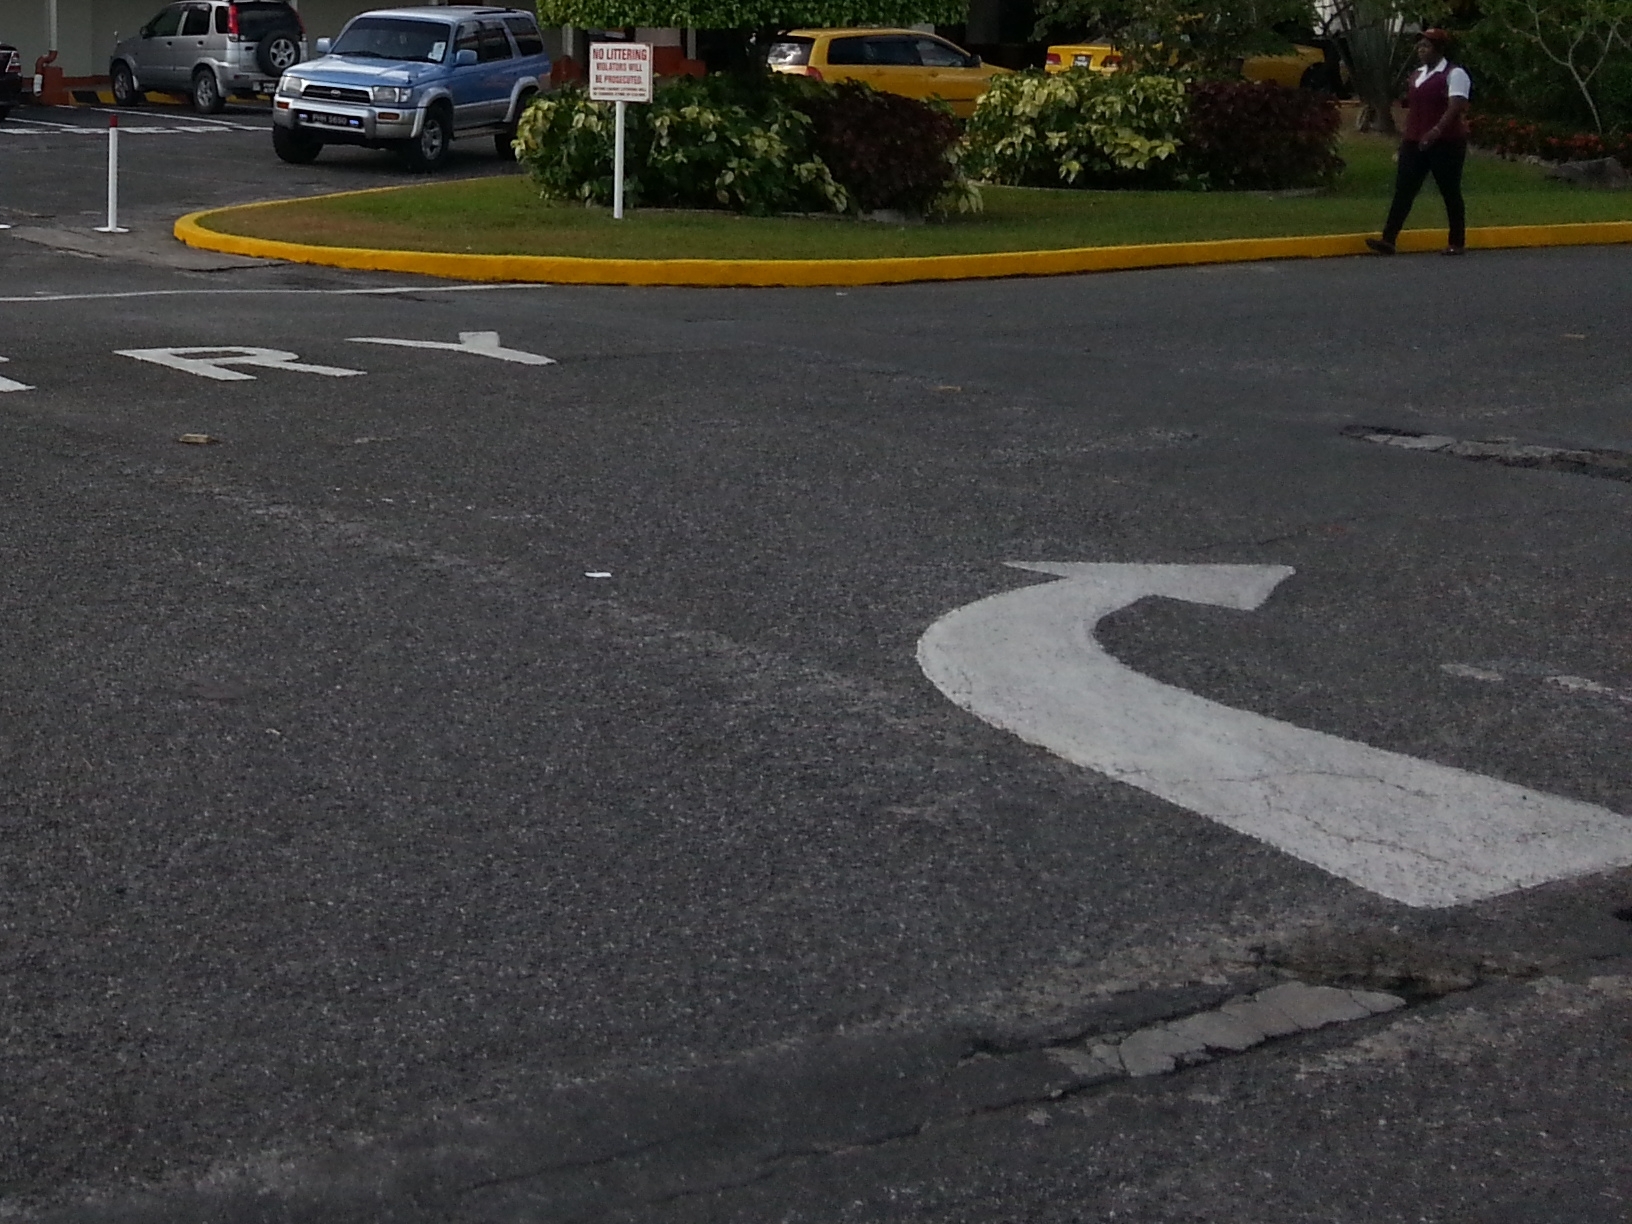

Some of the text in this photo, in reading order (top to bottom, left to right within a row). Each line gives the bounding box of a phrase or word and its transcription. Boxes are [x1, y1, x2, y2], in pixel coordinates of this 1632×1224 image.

[593, 48, 647, 61] NO LITTERING
[597, 62, 642, 72] VIOLATORS WILL
[595, 74, 602, 83] BE
